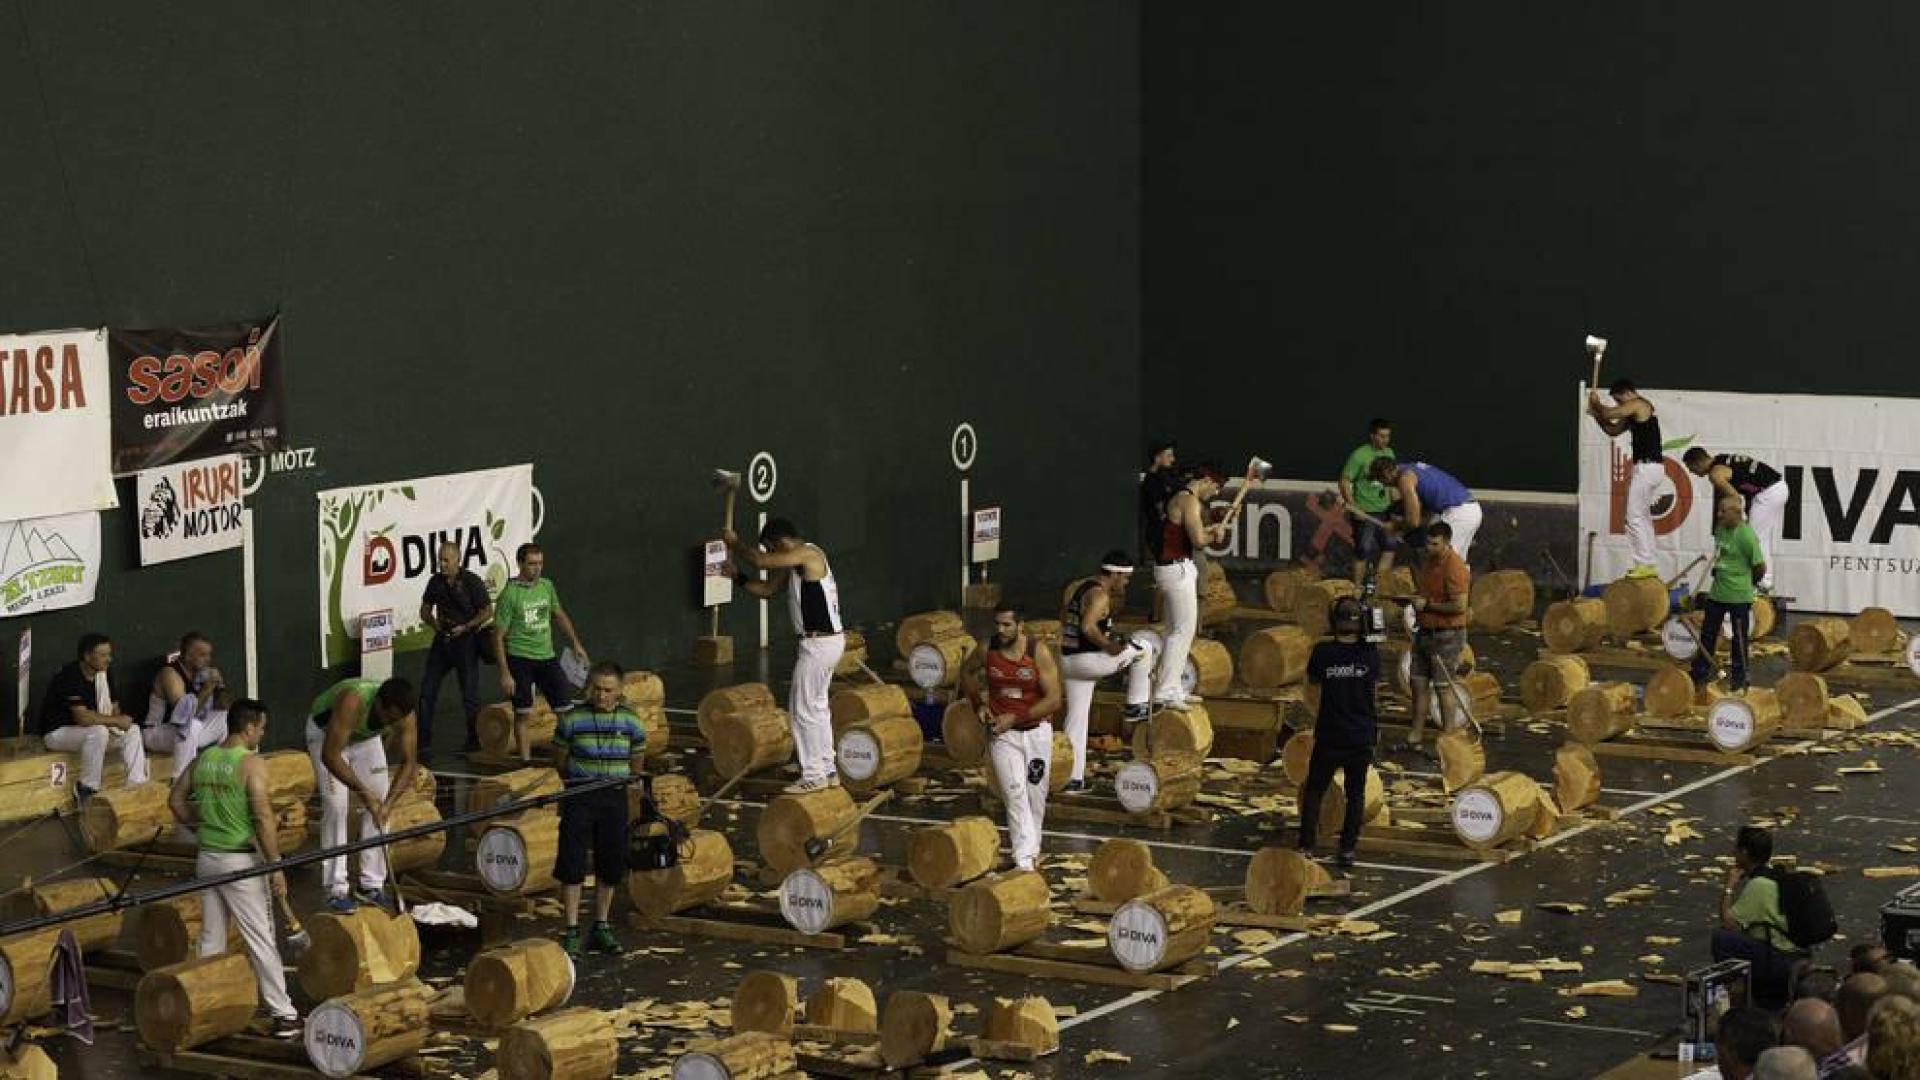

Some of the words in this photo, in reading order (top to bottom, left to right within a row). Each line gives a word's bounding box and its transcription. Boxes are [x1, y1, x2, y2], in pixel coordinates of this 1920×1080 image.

[127, 327, 261, 404] sasoi
[143, 399, 248, 429] eraikuntzak
[959, 436, 968, 457] 1
[182, 459, 240, 510] IRURI
[757, 465, 768, 489] 2
[1711, 464, 1920, 544] IVA
[183, 501, 242, 539] MOTOR
[1829, 555, 1920, 574] PENTSU
[53, 763, 64, 786] 2
[1130, 930, 1157, 944] DIVA
[327, 1033, 356, 1050] DIVA
